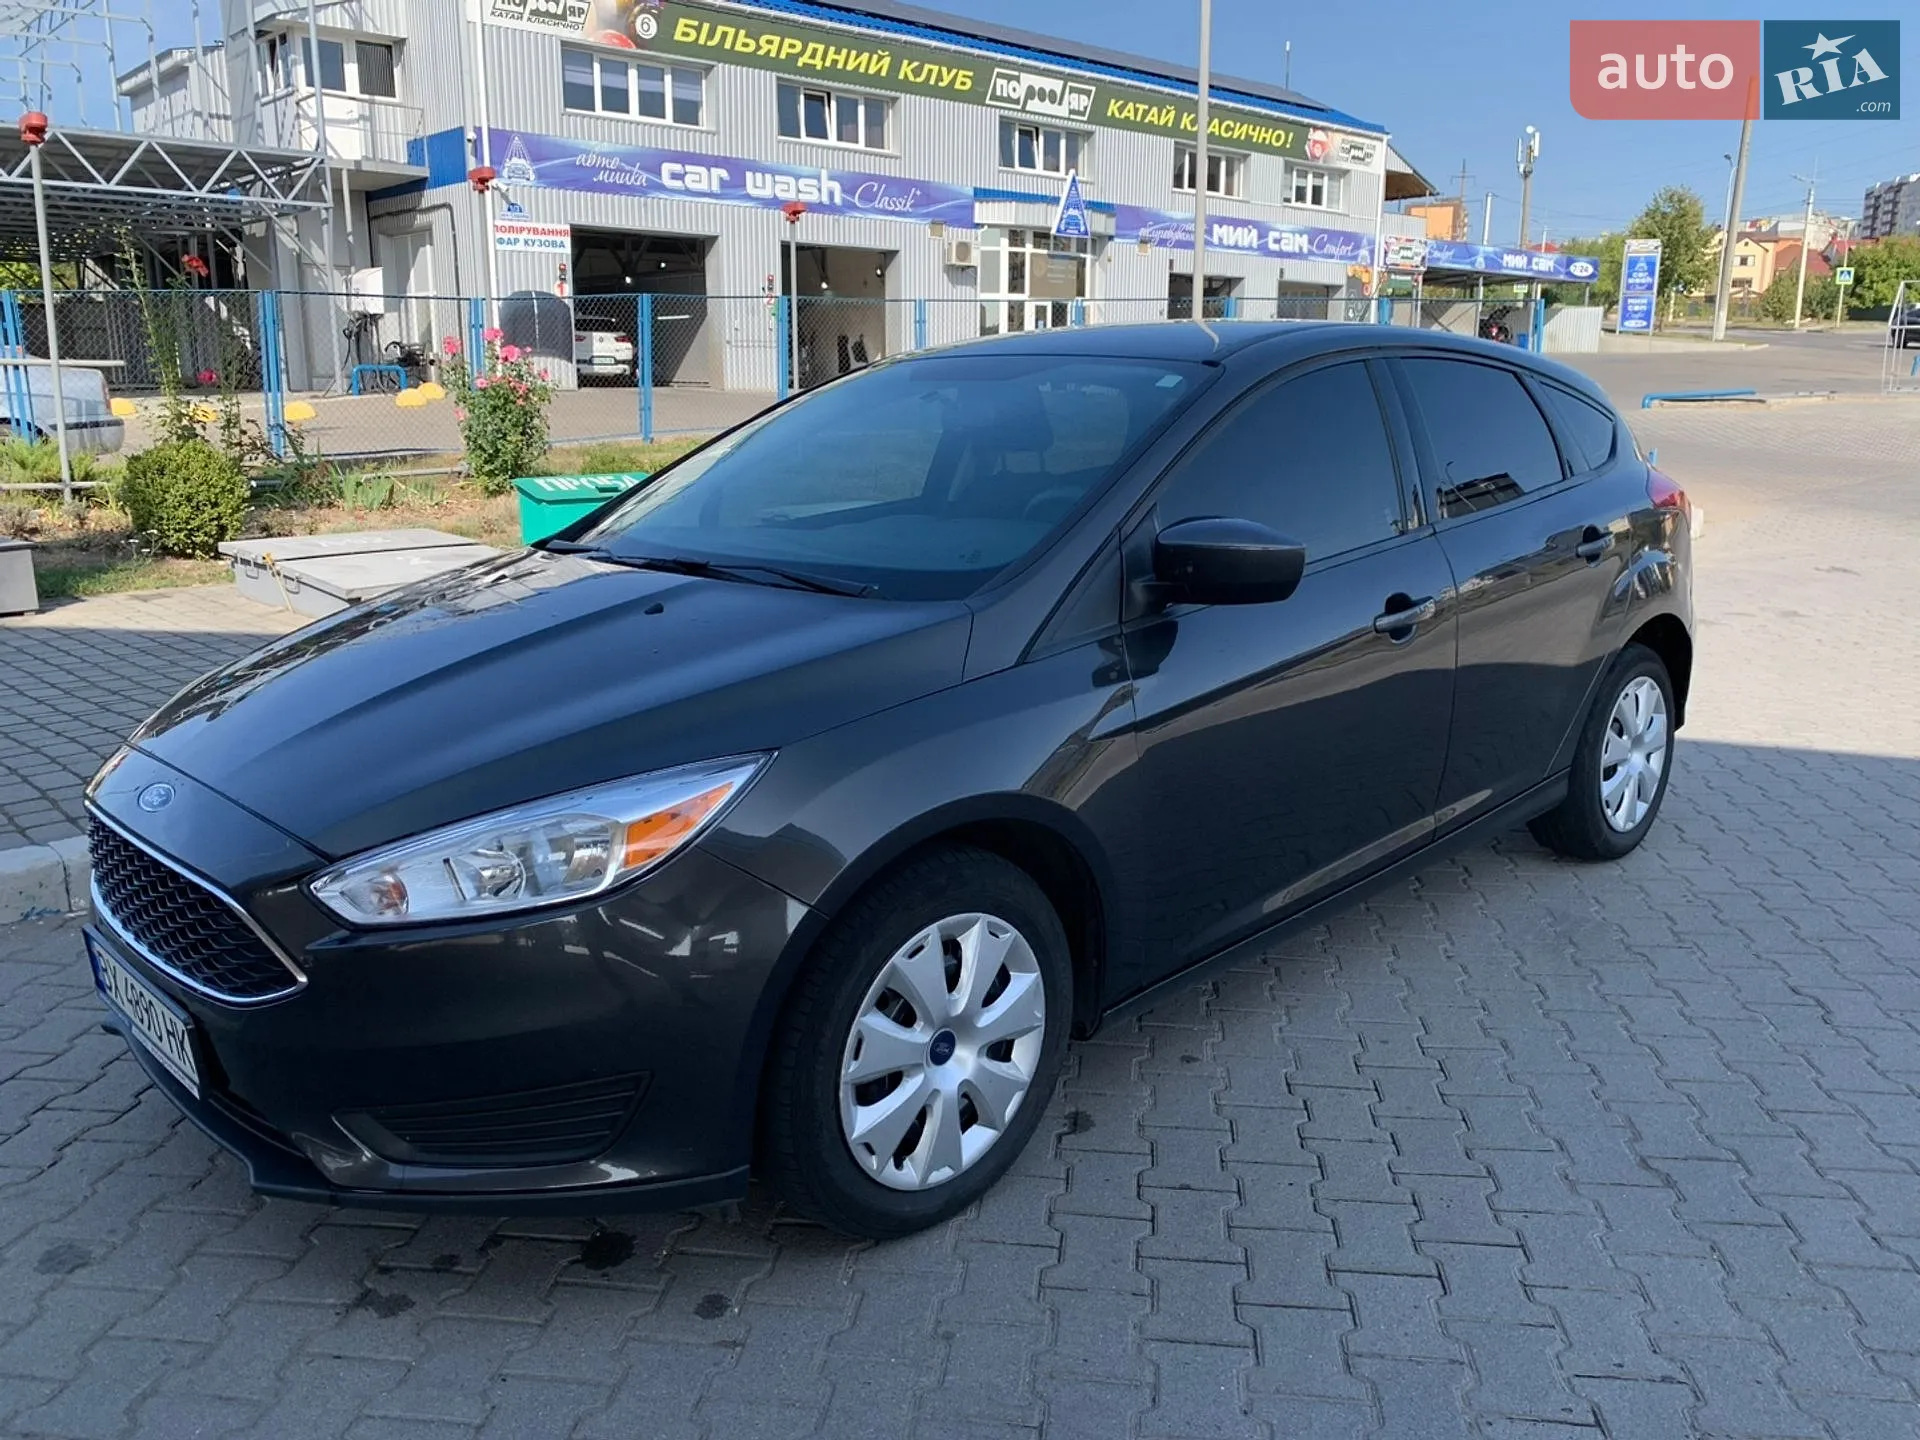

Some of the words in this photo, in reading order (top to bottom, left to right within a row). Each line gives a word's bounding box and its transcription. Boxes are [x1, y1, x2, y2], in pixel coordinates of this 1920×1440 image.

[640, 16, 651, 33] 6
[673, 17, 891, 77] БІЛЬЯРДНИЙ
[898, 58, 974, 91] КЛУБ
[1106, 98, 1175, 128] КАТАЙ
[1180, 112, 1295, 149] КАСИЧНО!
[660, 161, 730, 194] car
[745, 168, 842, 206] wash
[496, 237, 520, 246] ФАР
[523, 238, 566, 249] КУЗОВА
[125, 976, 163, 1044] 4890
[162, 1010, 196, 1074] HK
